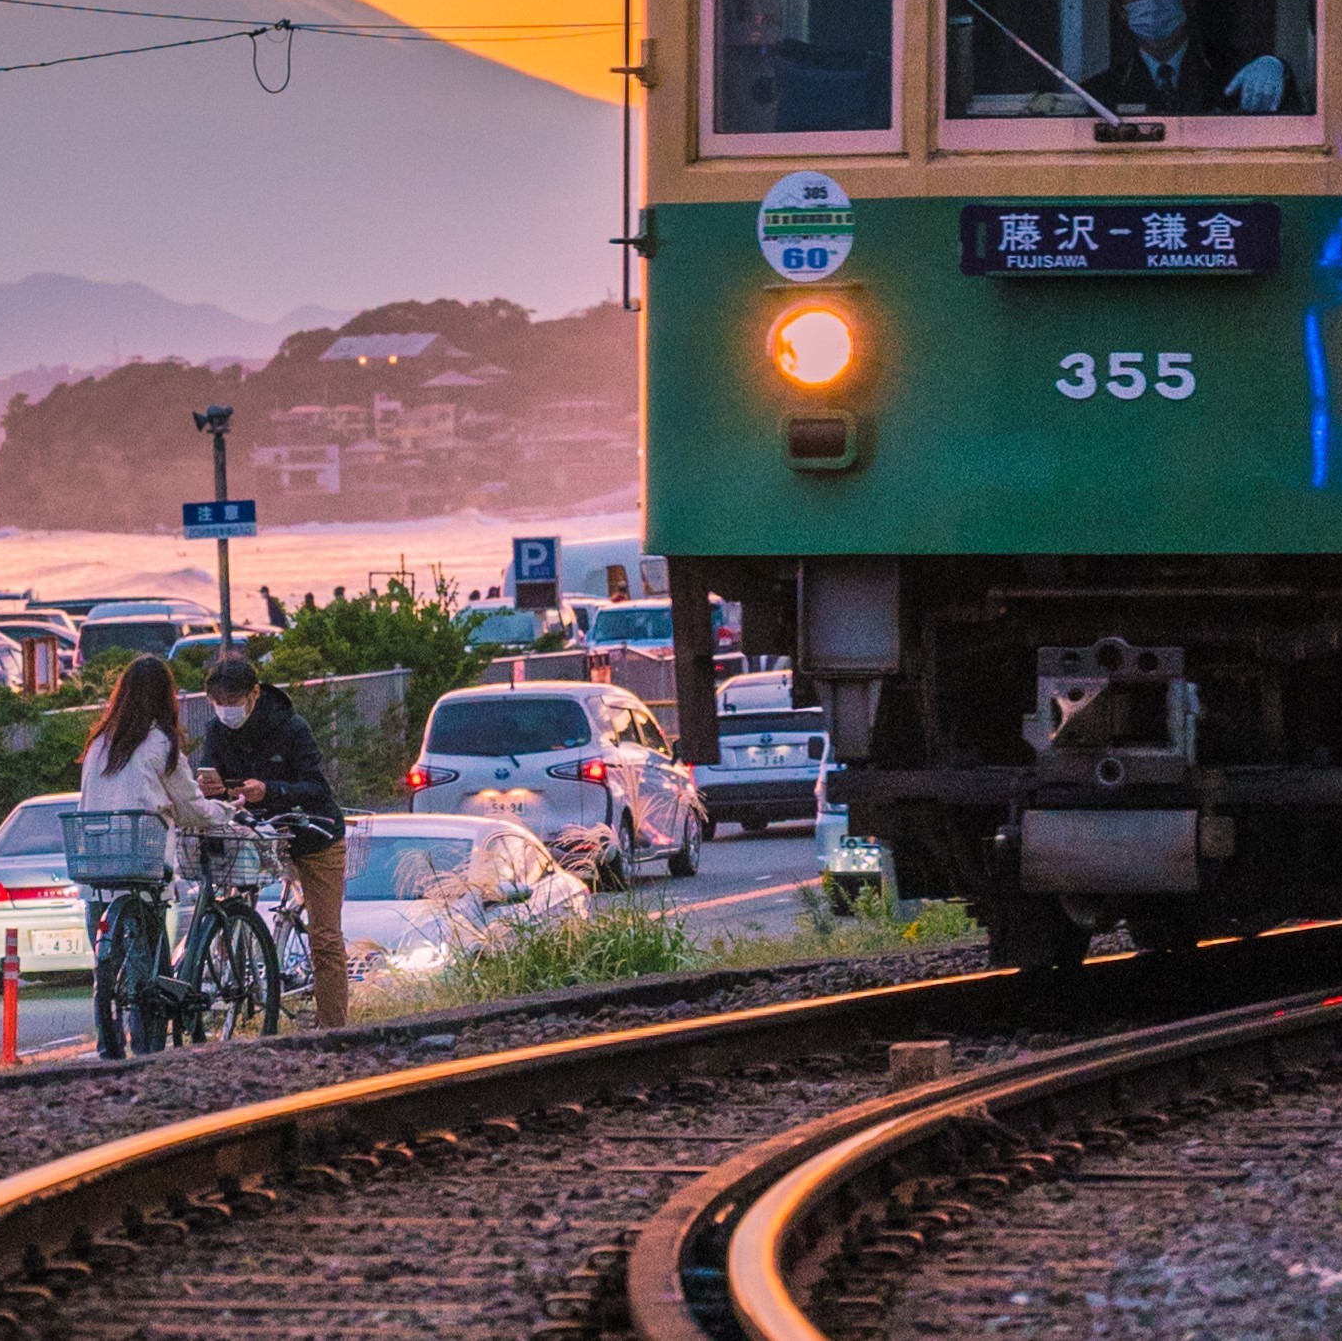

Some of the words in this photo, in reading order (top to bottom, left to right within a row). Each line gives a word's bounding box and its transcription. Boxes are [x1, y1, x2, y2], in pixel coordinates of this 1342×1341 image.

[1007, 254, 1088, 269] FUJISAWA
[1147, 253, 1238, 268] KAMAKURA
[1055, 352, 1197, 400] 355
[521, 542, 548, 576] P
